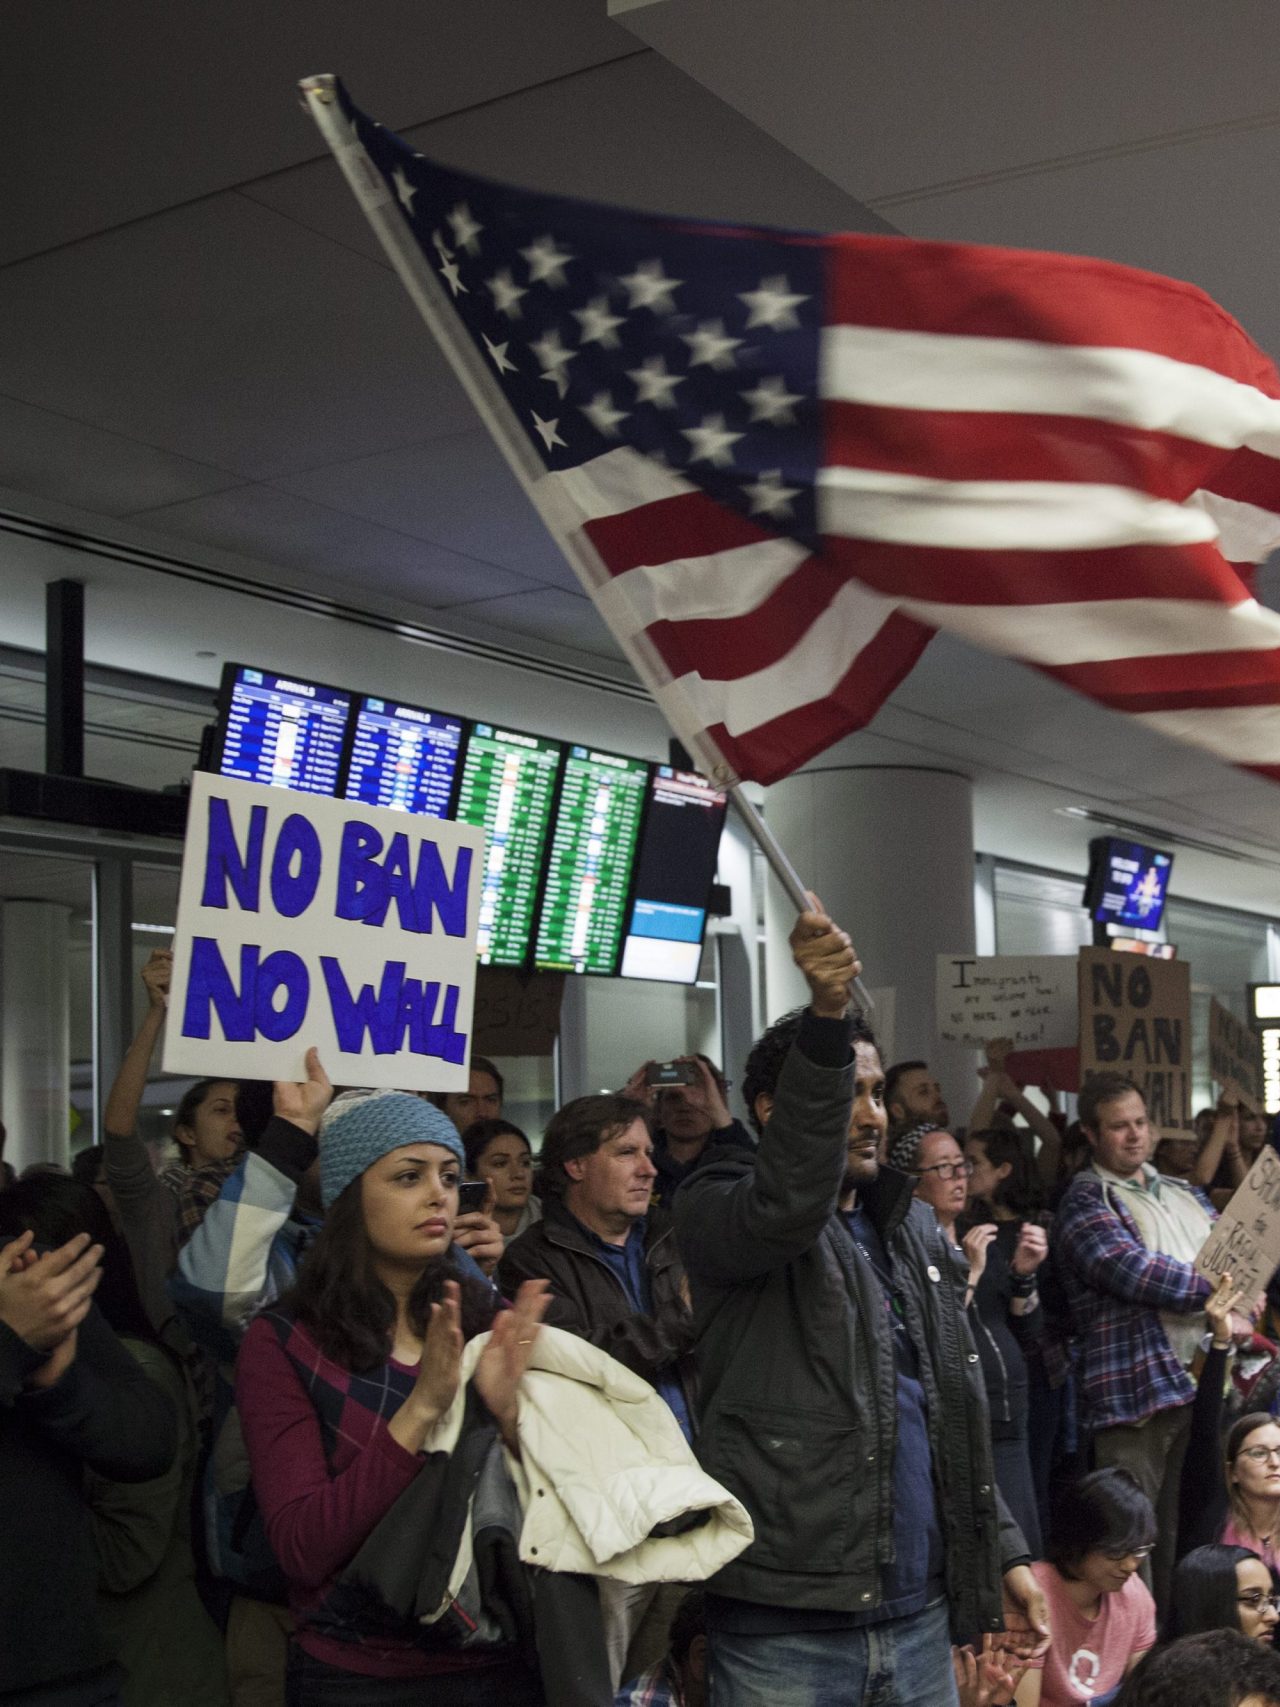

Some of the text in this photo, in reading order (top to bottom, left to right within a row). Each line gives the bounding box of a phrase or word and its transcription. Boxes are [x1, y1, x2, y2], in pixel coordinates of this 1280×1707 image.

[200, 796, 322, 919] NO
[334, 820, 473, 938] BAN
[181, 936, 468, 1066] NO WALL
[1091, 963, 1152, 1008] NO
[1092, 1014, 1182, 1065] BAN
